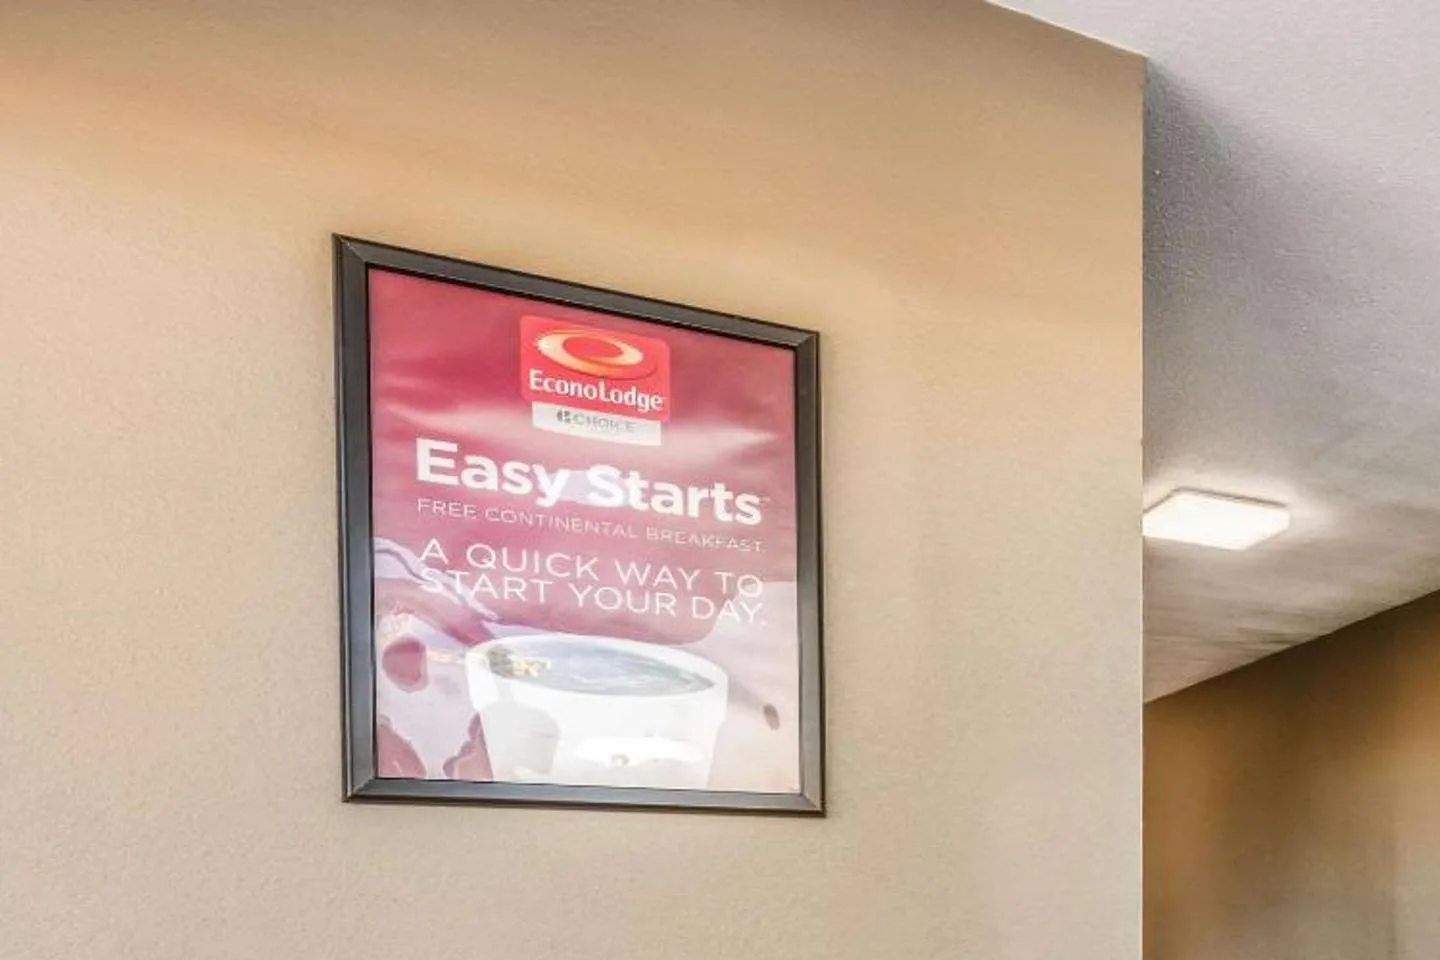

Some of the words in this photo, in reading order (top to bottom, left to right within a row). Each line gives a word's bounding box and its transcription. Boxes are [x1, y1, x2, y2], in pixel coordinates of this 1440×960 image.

[529, 368, 663, 413] EconoLodge
[416, 437, 571, 508] Easy
[586, 464, 763, 525] Starts
[417, 498, 478, 521] FREE
[484, 508, 638, 539] CONTINENTAL
[419, 538, 449, 565] A
[466, 543, 600, 581] QUICK
[614, 560, 701, 591] WAY
[714, 571, 764, 598] TO
[420, 567, 554, 604] START
[568, 586, 677, 617] YOUR
[691, 597, 768, 627] DAY.
